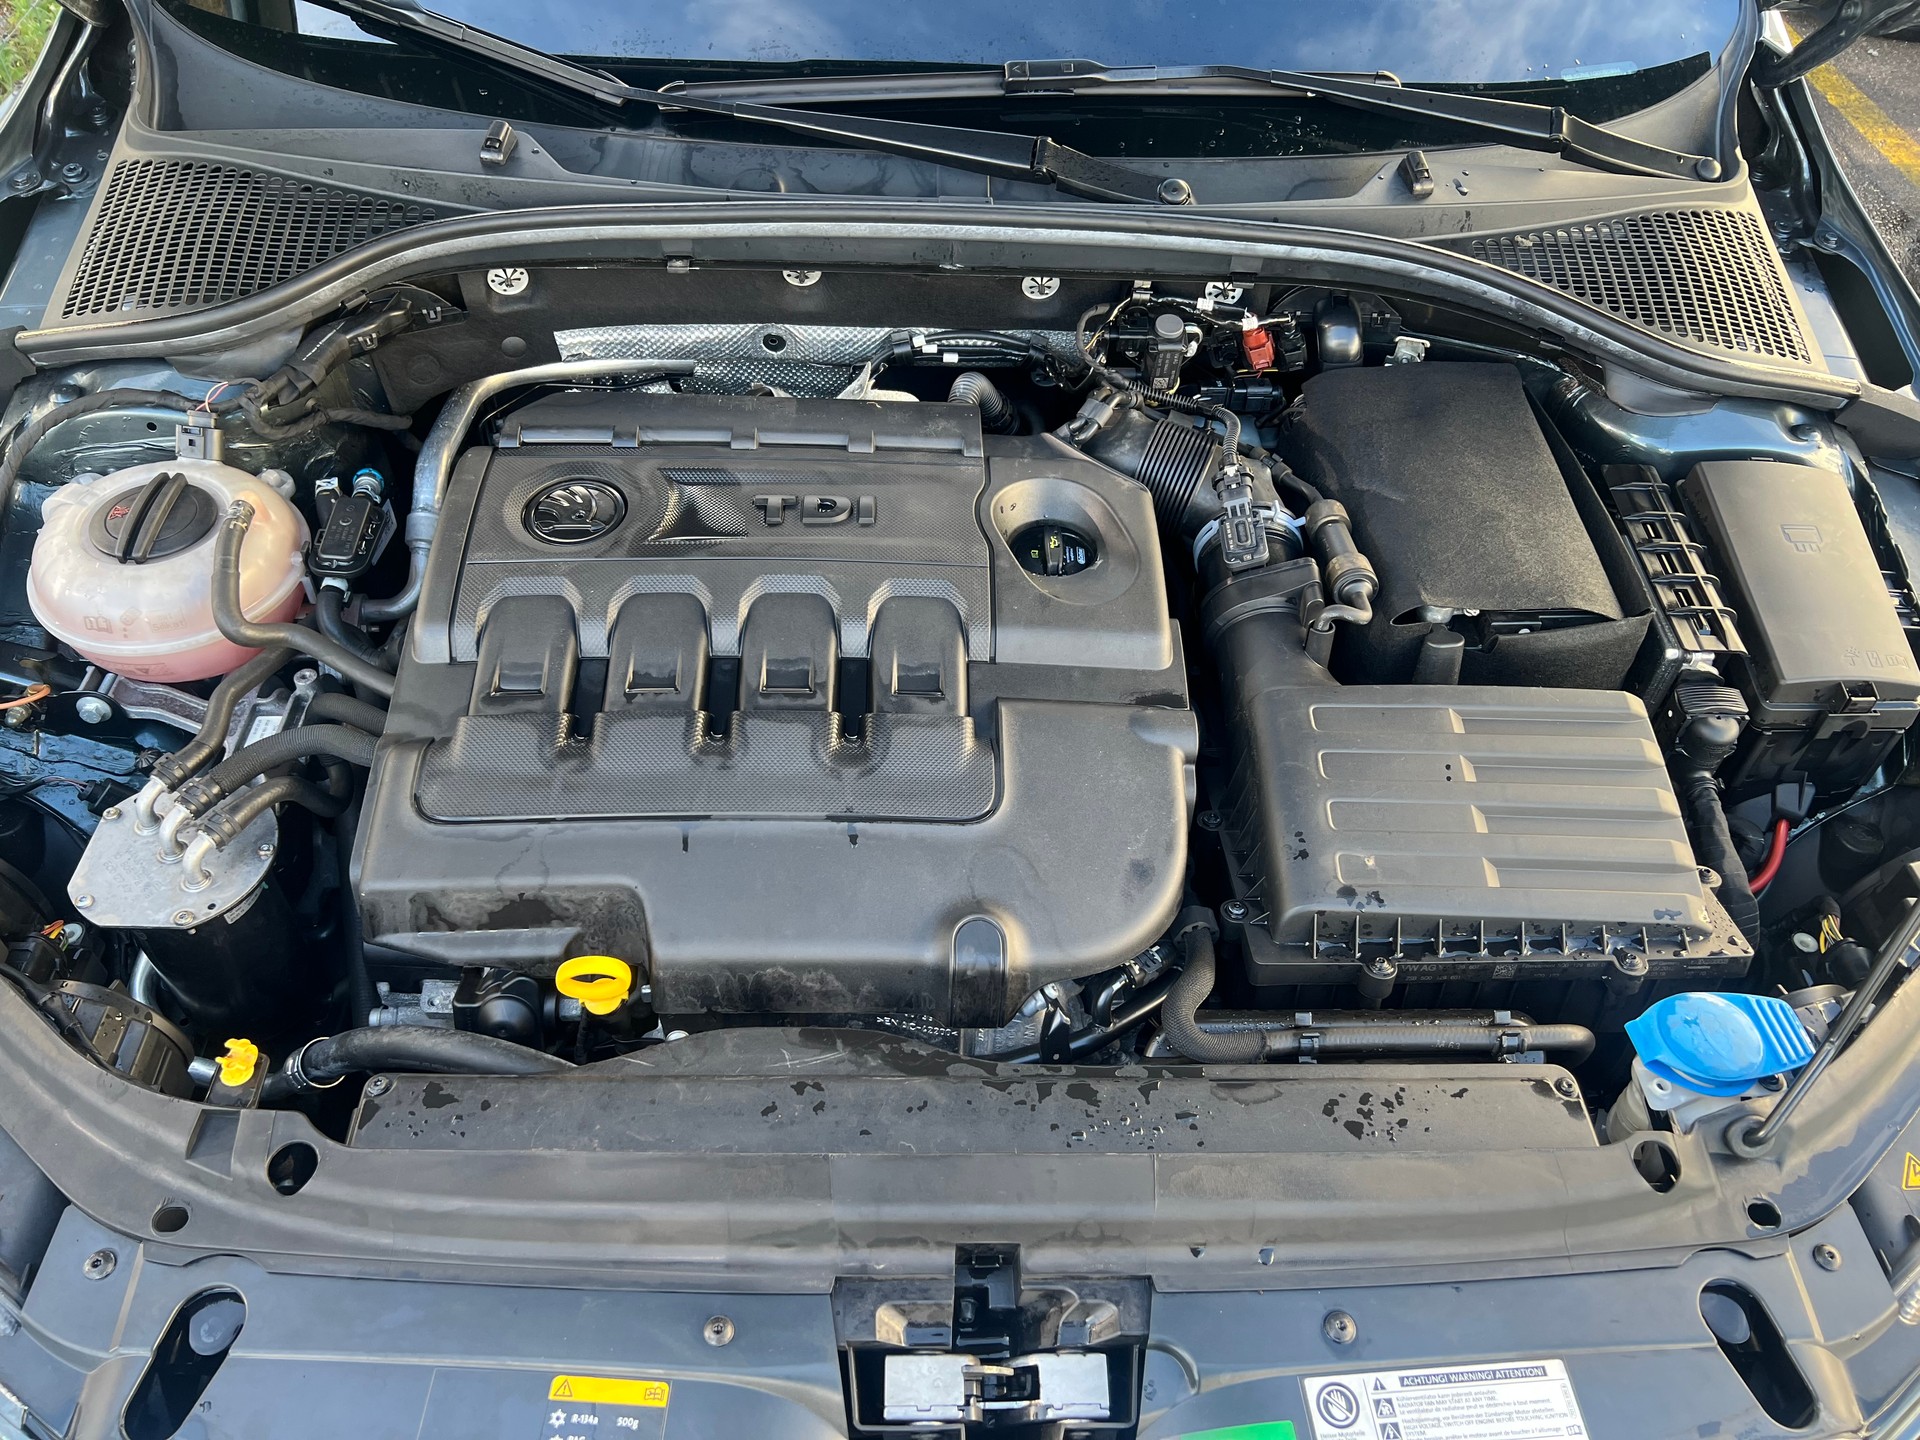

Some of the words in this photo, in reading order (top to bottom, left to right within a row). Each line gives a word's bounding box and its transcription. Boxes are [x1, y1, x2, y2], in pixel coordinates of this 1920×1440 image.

[752, 494, 876, 525] TDI
[1402, 964, 1419, 972] VW
[1420, 964, 1437, 972] AG
[1403, 1375, 1448, 1387] ACHTUNG!
[1449, 1371, 1494, 1383] WARNING!
[1495, 1366, 1545, 1379] ATTENTION!
[570, 1413, 599, 1425] R-134a
[616, 1416, 640, 1431] 500g
